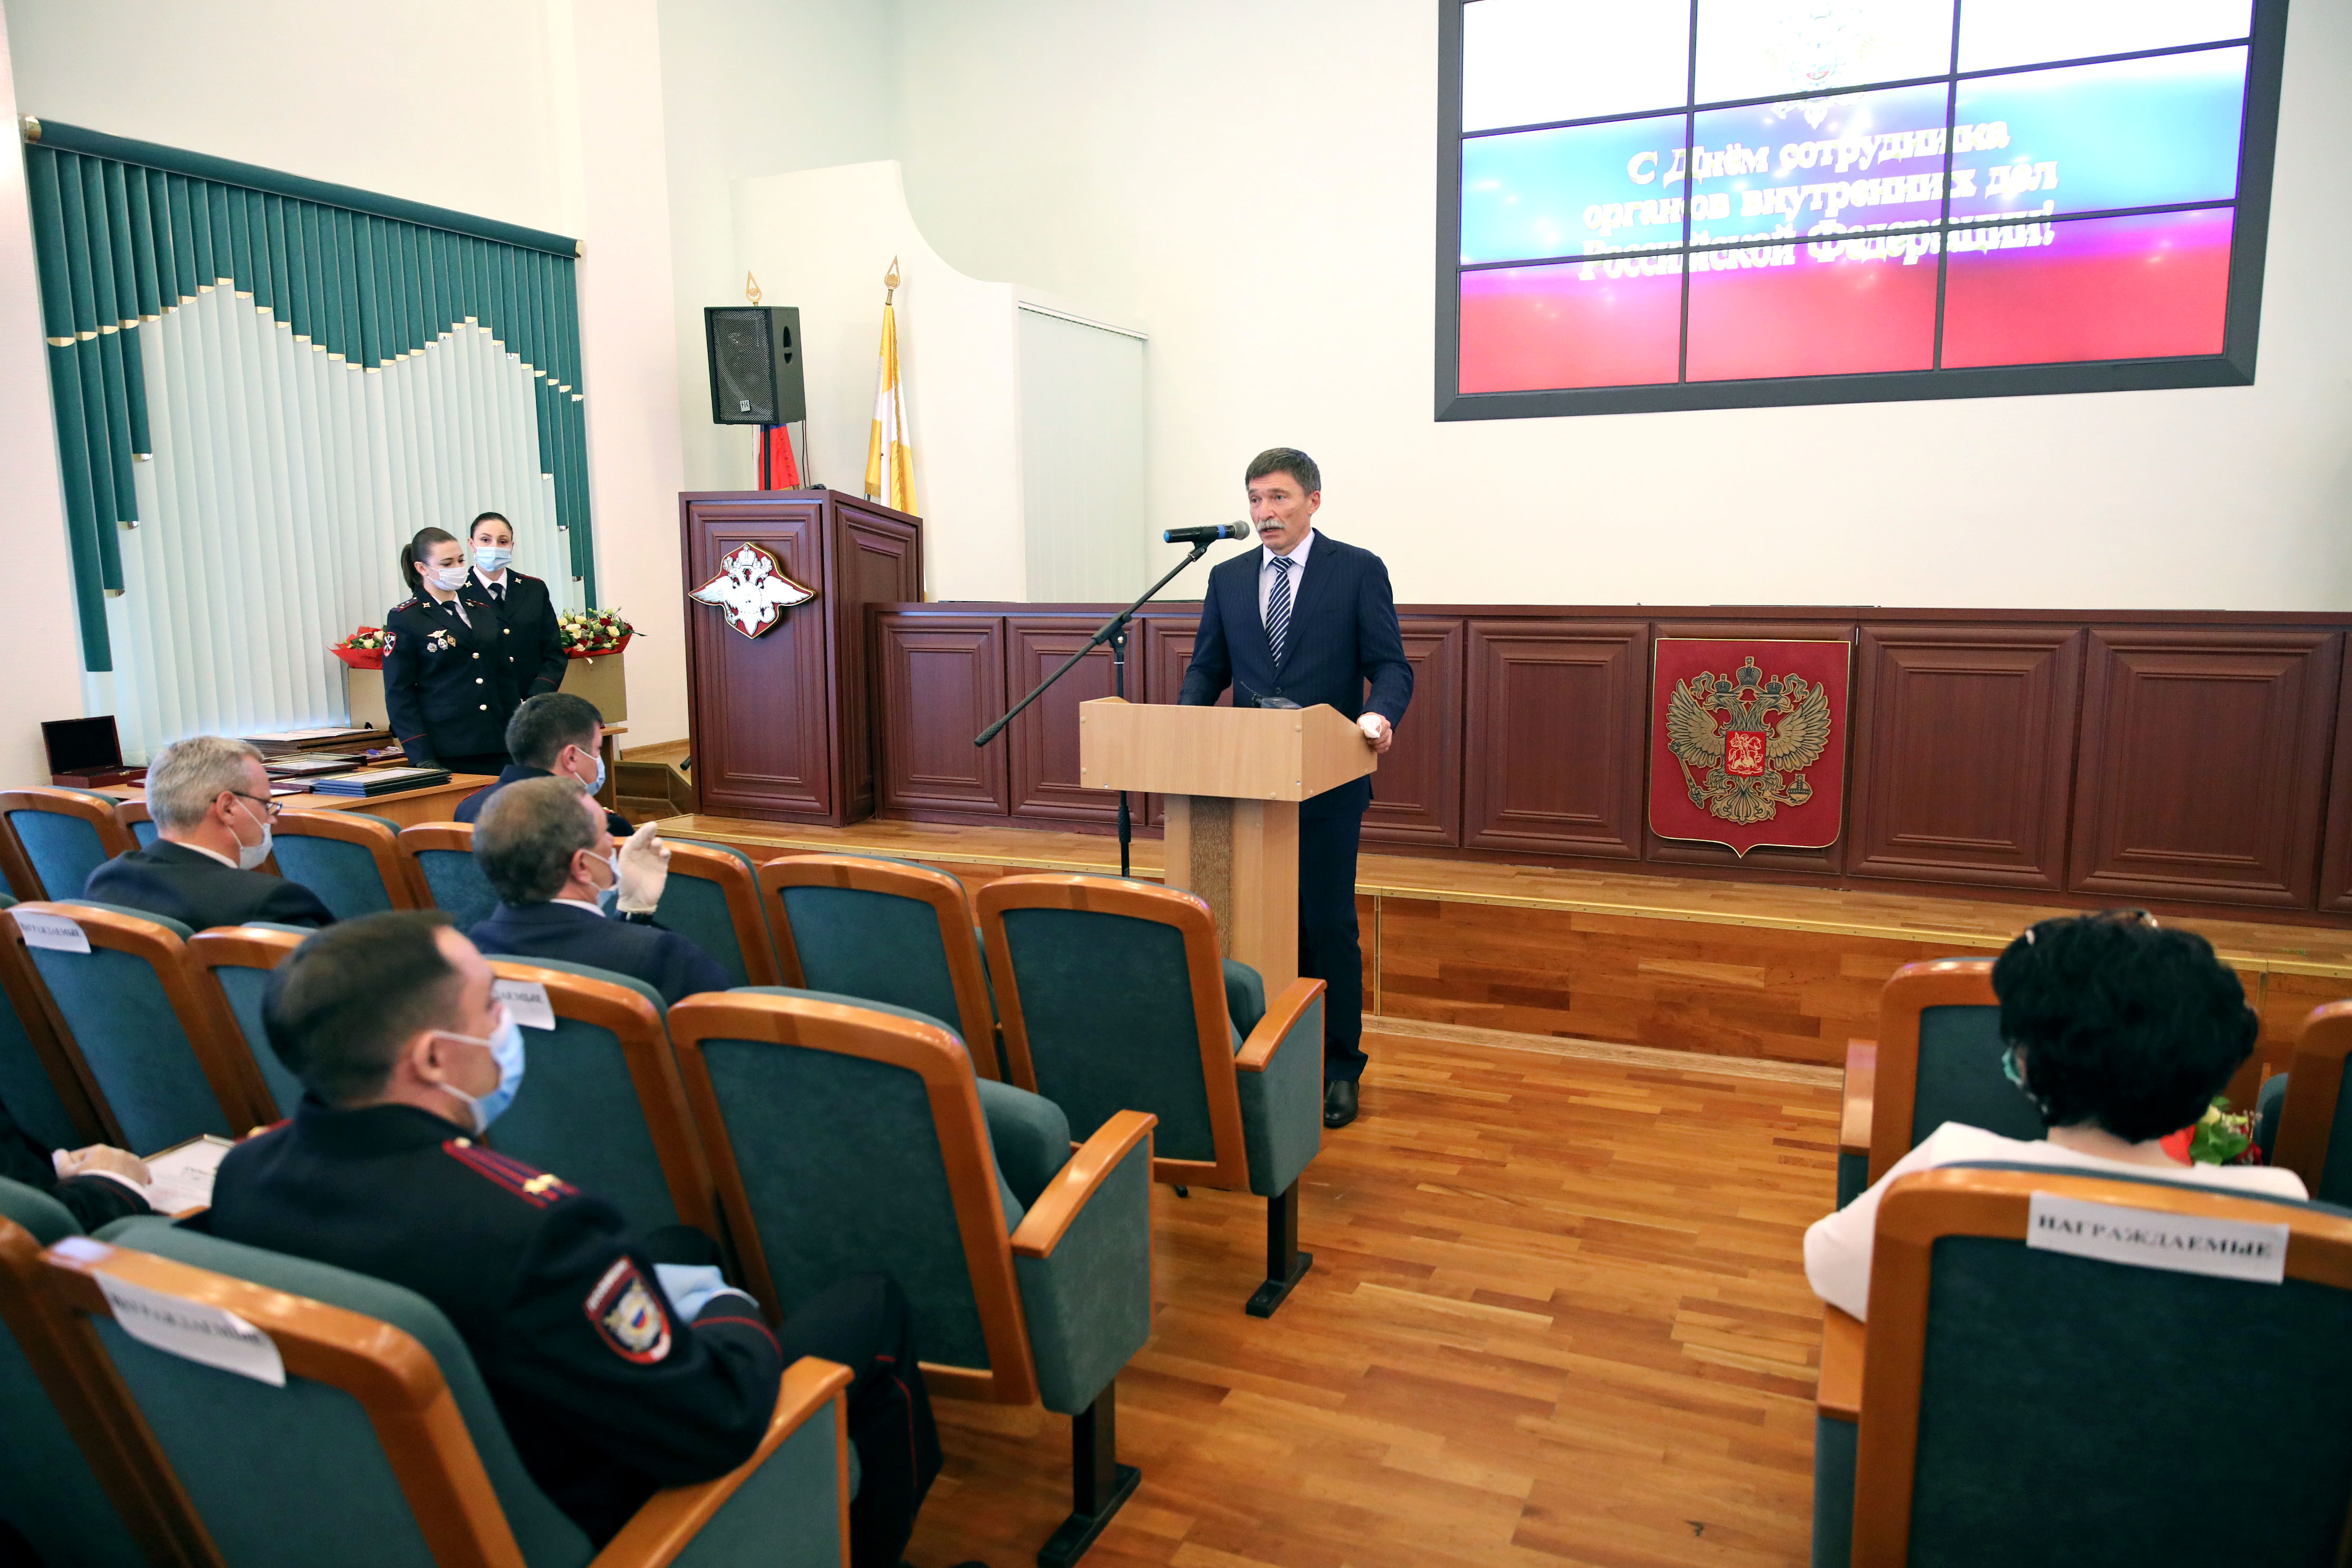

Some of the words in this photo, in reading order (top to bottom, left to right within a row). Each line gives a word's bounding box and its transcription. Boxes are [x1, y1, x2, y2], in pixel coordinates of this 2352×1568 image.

[1628, 151, 1658, 184] С
[1663, 143, 1769, 189] Днём
[1779, 121, 2011, 173] сотрудника
[1583, 193, 1730, 237] органов
[1741, 169, 1977, 221] внутренних
[1578, 223, 1797, 280] Российской
[1808, 199, 2055, 265] Федерации!
[2039, 1215, 2273, 1257] НАГРАЖДАЕМЫЕ
